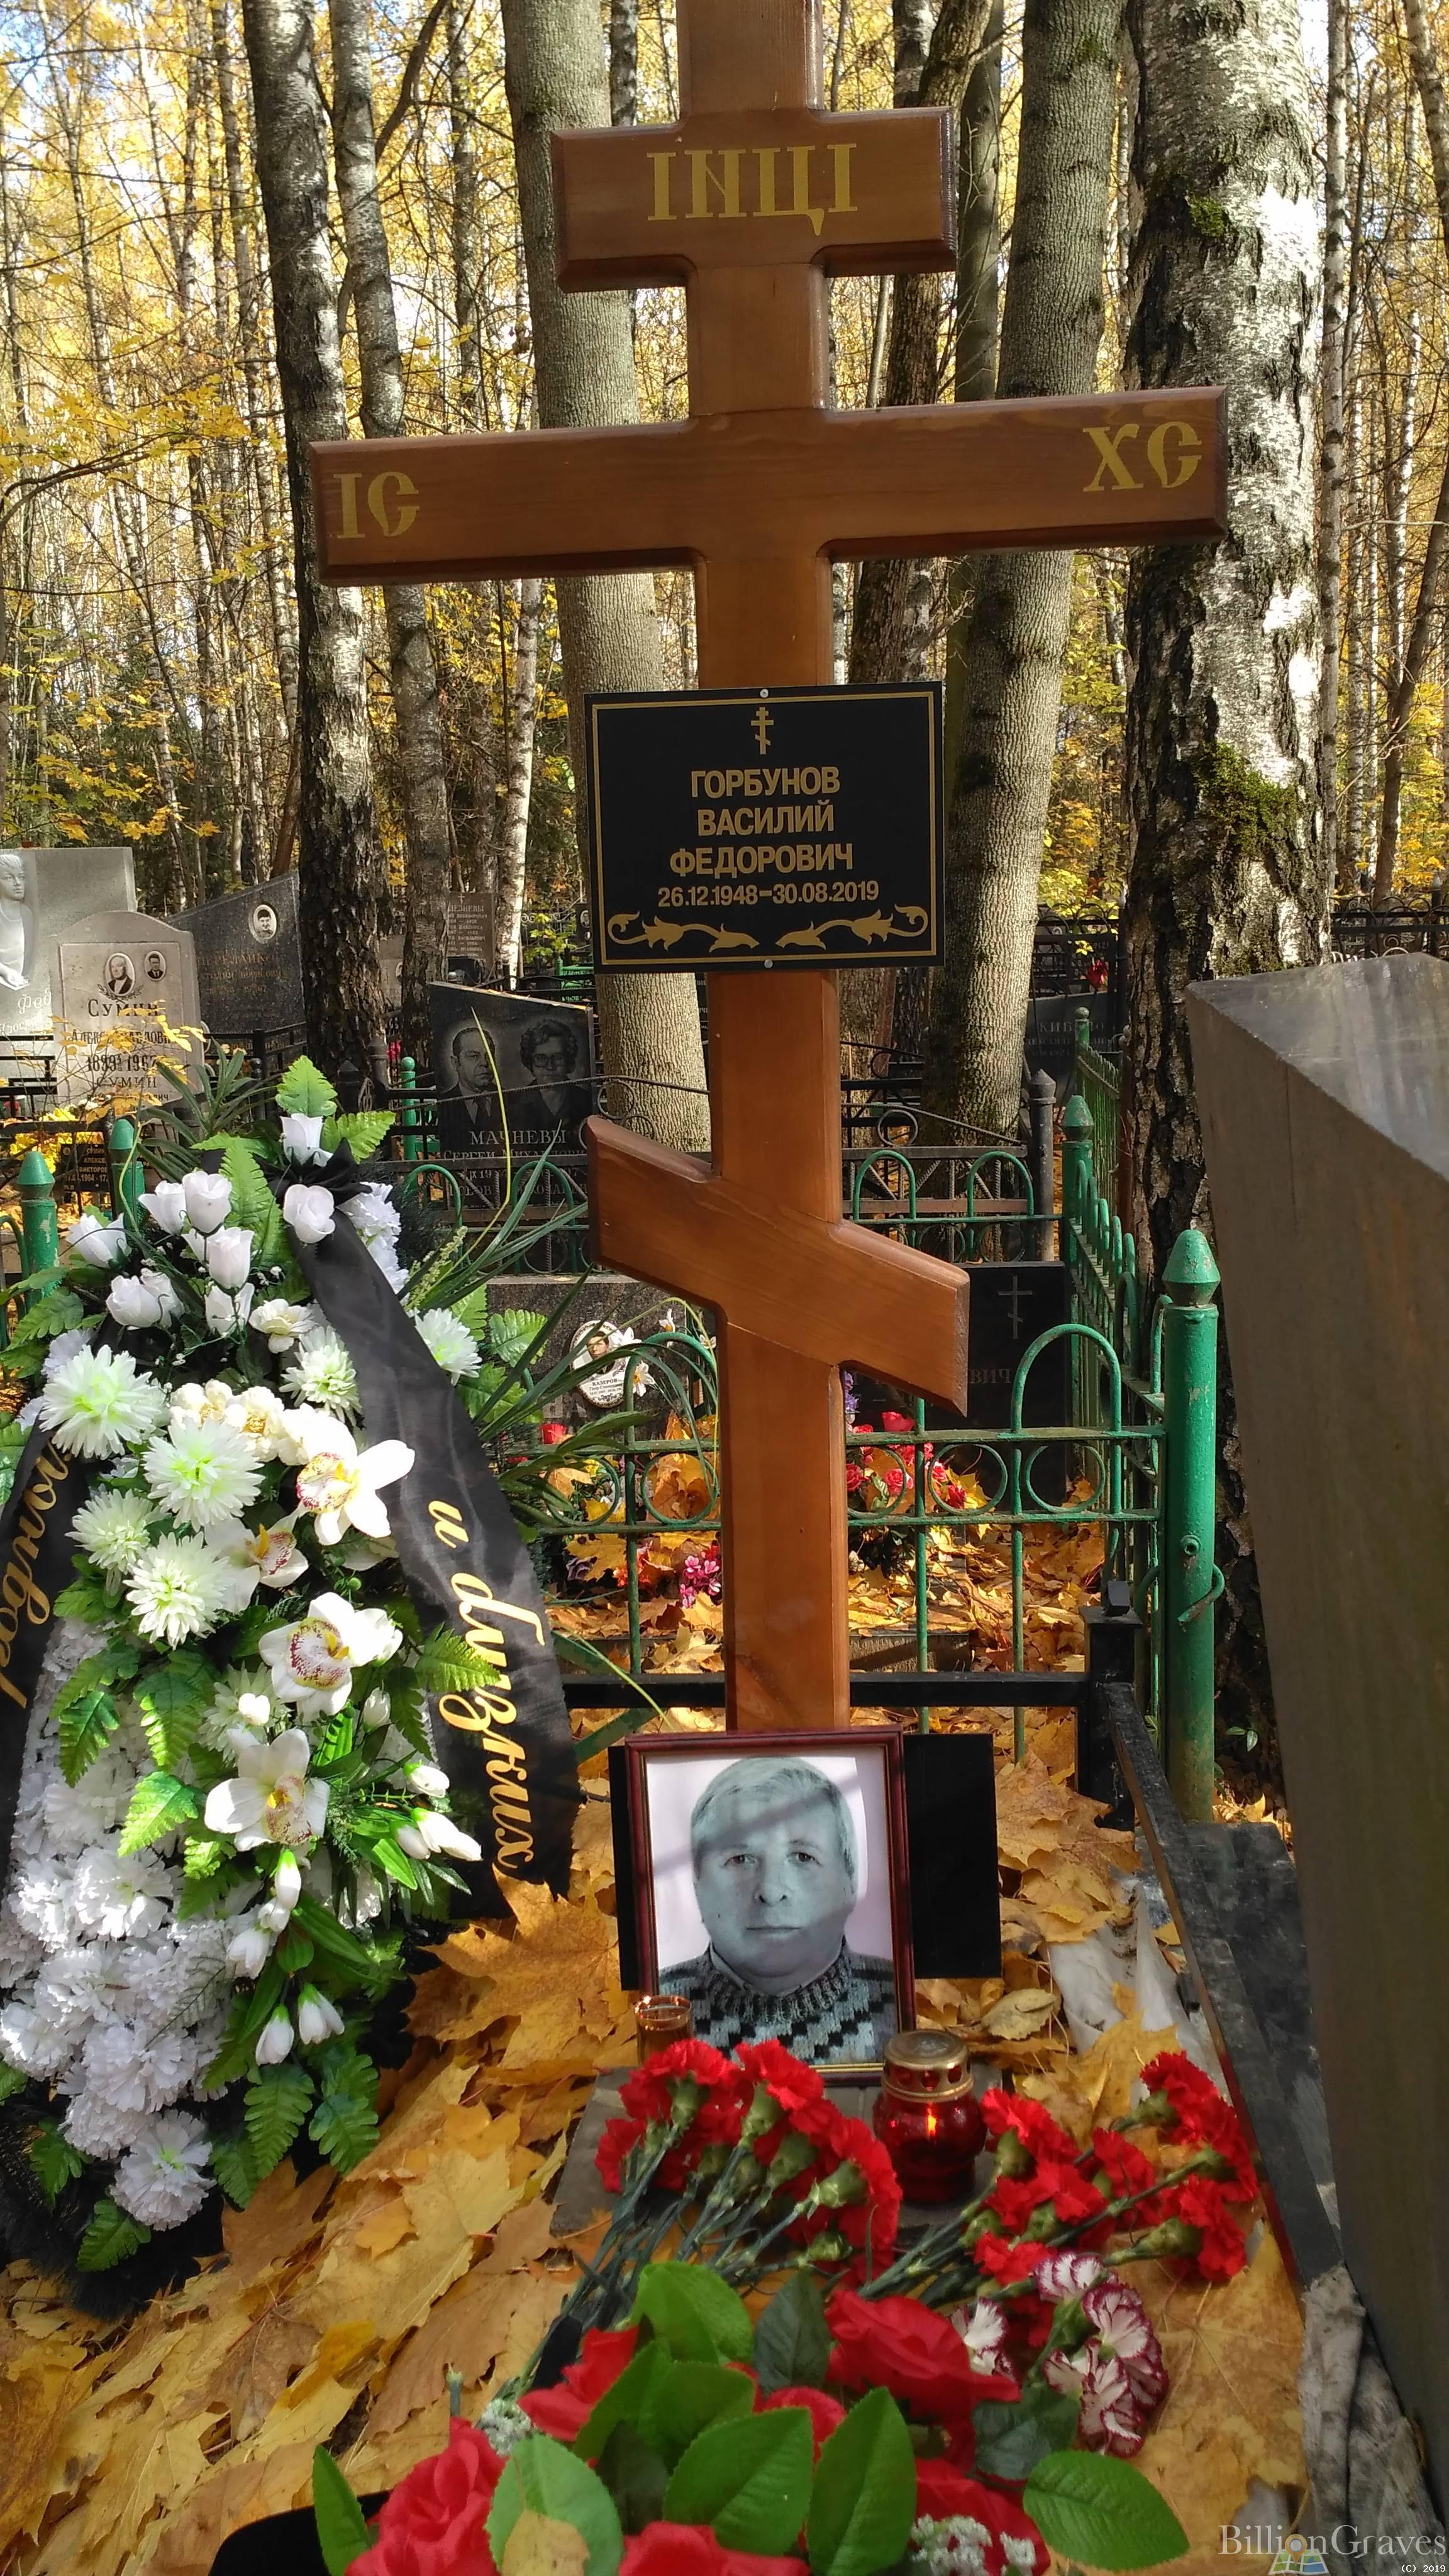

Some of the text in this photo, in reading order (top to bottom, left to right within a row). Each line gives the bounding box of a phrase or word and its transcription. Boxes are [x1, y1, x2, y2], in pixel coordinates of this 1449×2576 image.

[691, 767, 840, 798] ГОРБУНОВ
[697, 799, 834, 836] ВАСИЛИЙ
[670, 843, 853, 879] ФЕДОРОВИЧ
